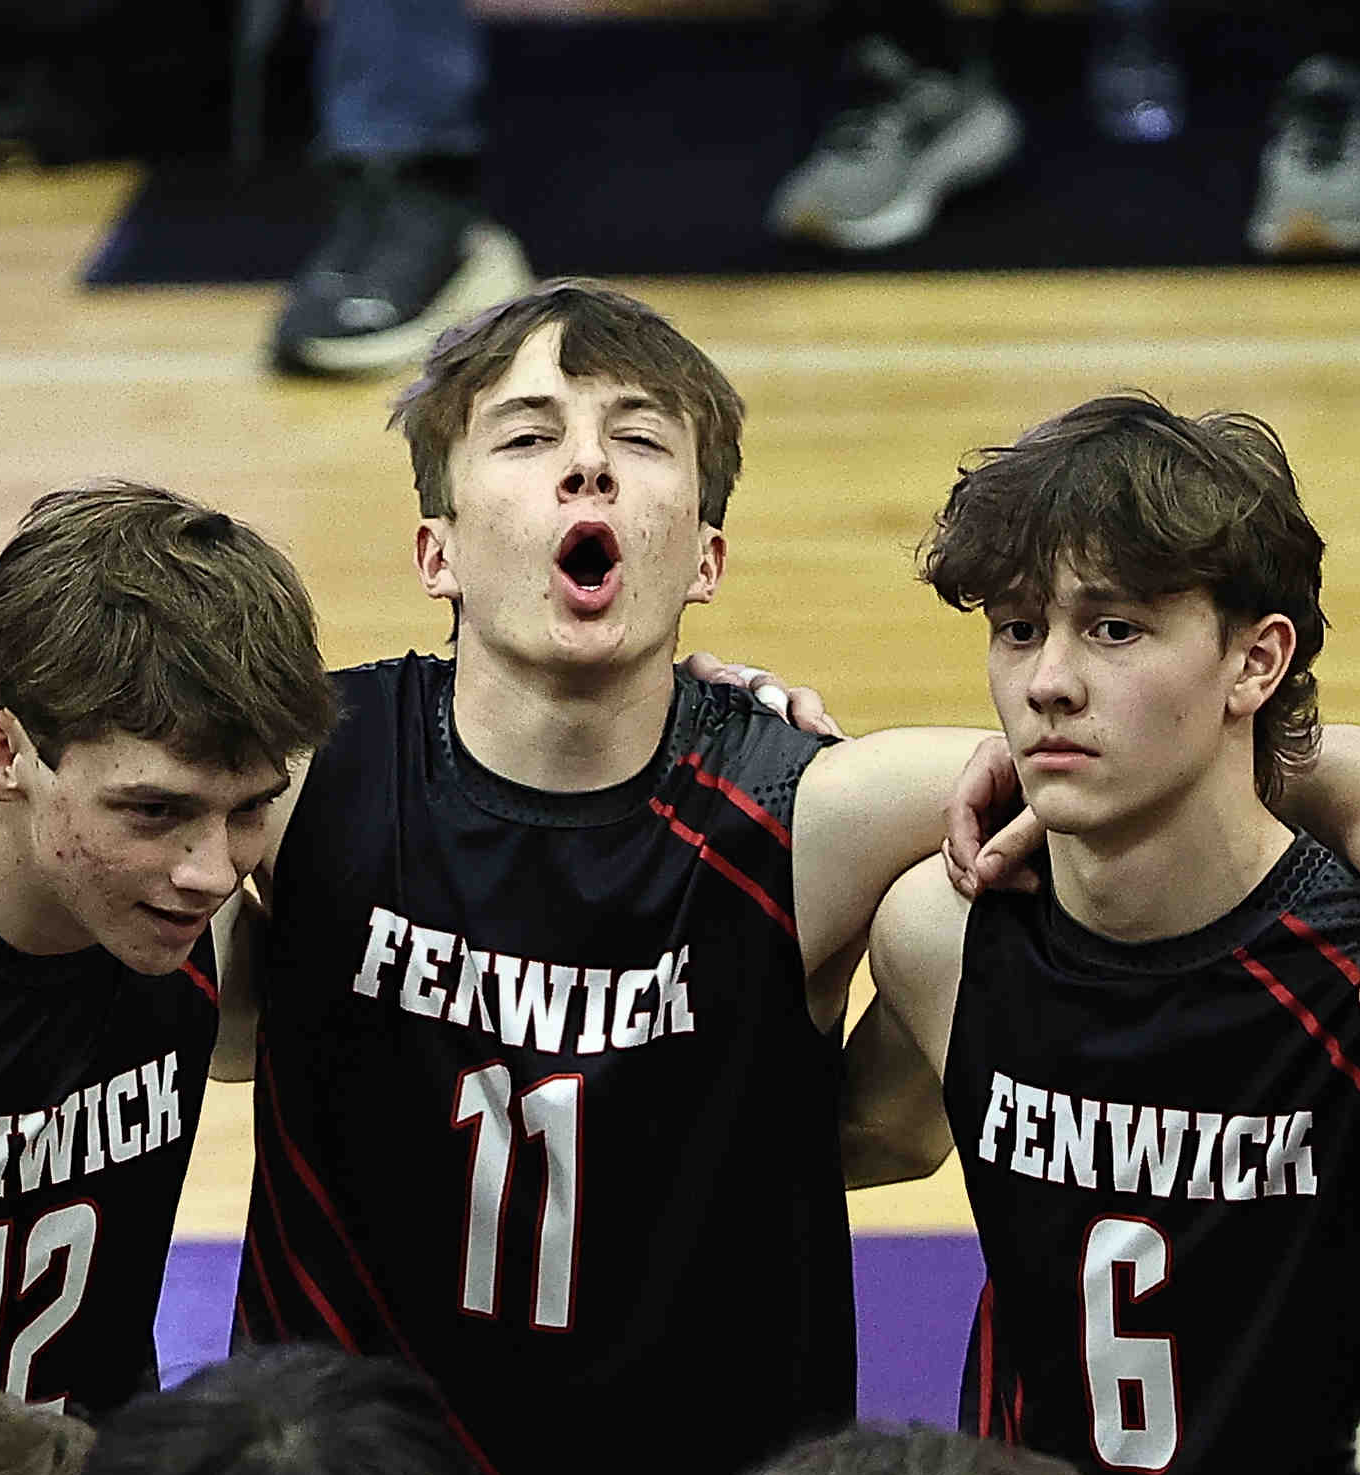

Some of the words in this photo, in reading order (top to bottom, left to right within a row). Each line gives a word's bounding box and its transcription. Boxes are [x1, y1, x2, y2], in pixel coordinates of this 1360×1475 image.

[352, 905, 697, 1055] FENWICK
[449, 1057, 584, 1332] 11
[978, 1071, 1318, 1201] FENWICK
[1079, 1214, 1184, 1475] 6
